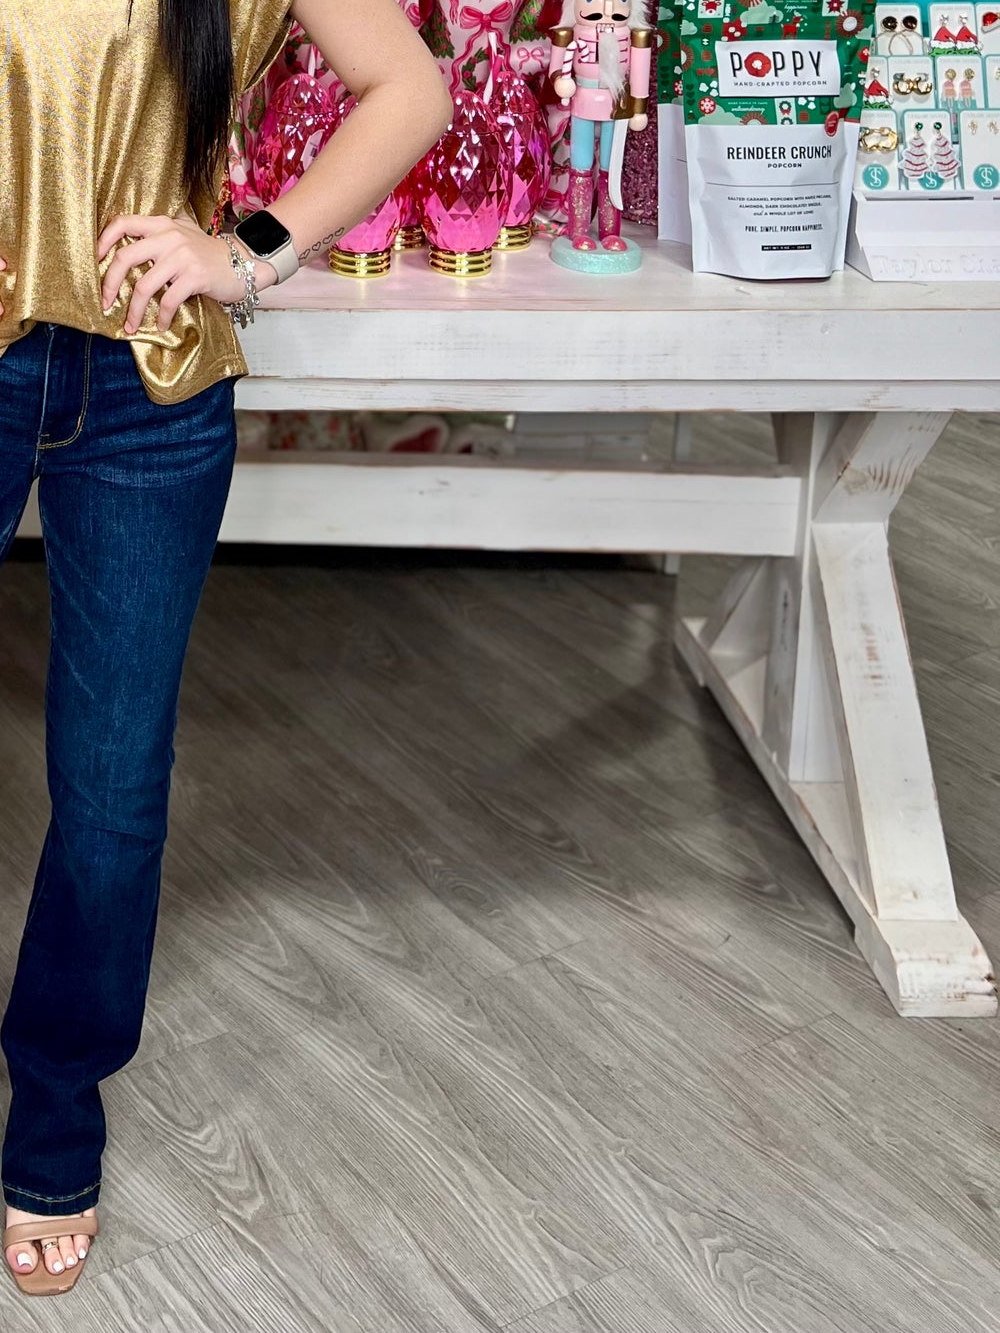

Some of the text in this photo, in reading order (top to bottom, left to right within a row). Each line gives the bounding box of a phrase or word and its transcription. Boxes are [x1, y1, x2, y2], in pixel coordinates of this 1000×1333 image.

[730, 51, 821, 78] POPPY
[727, 145, 832, 159] REINDEER CRUNCH
